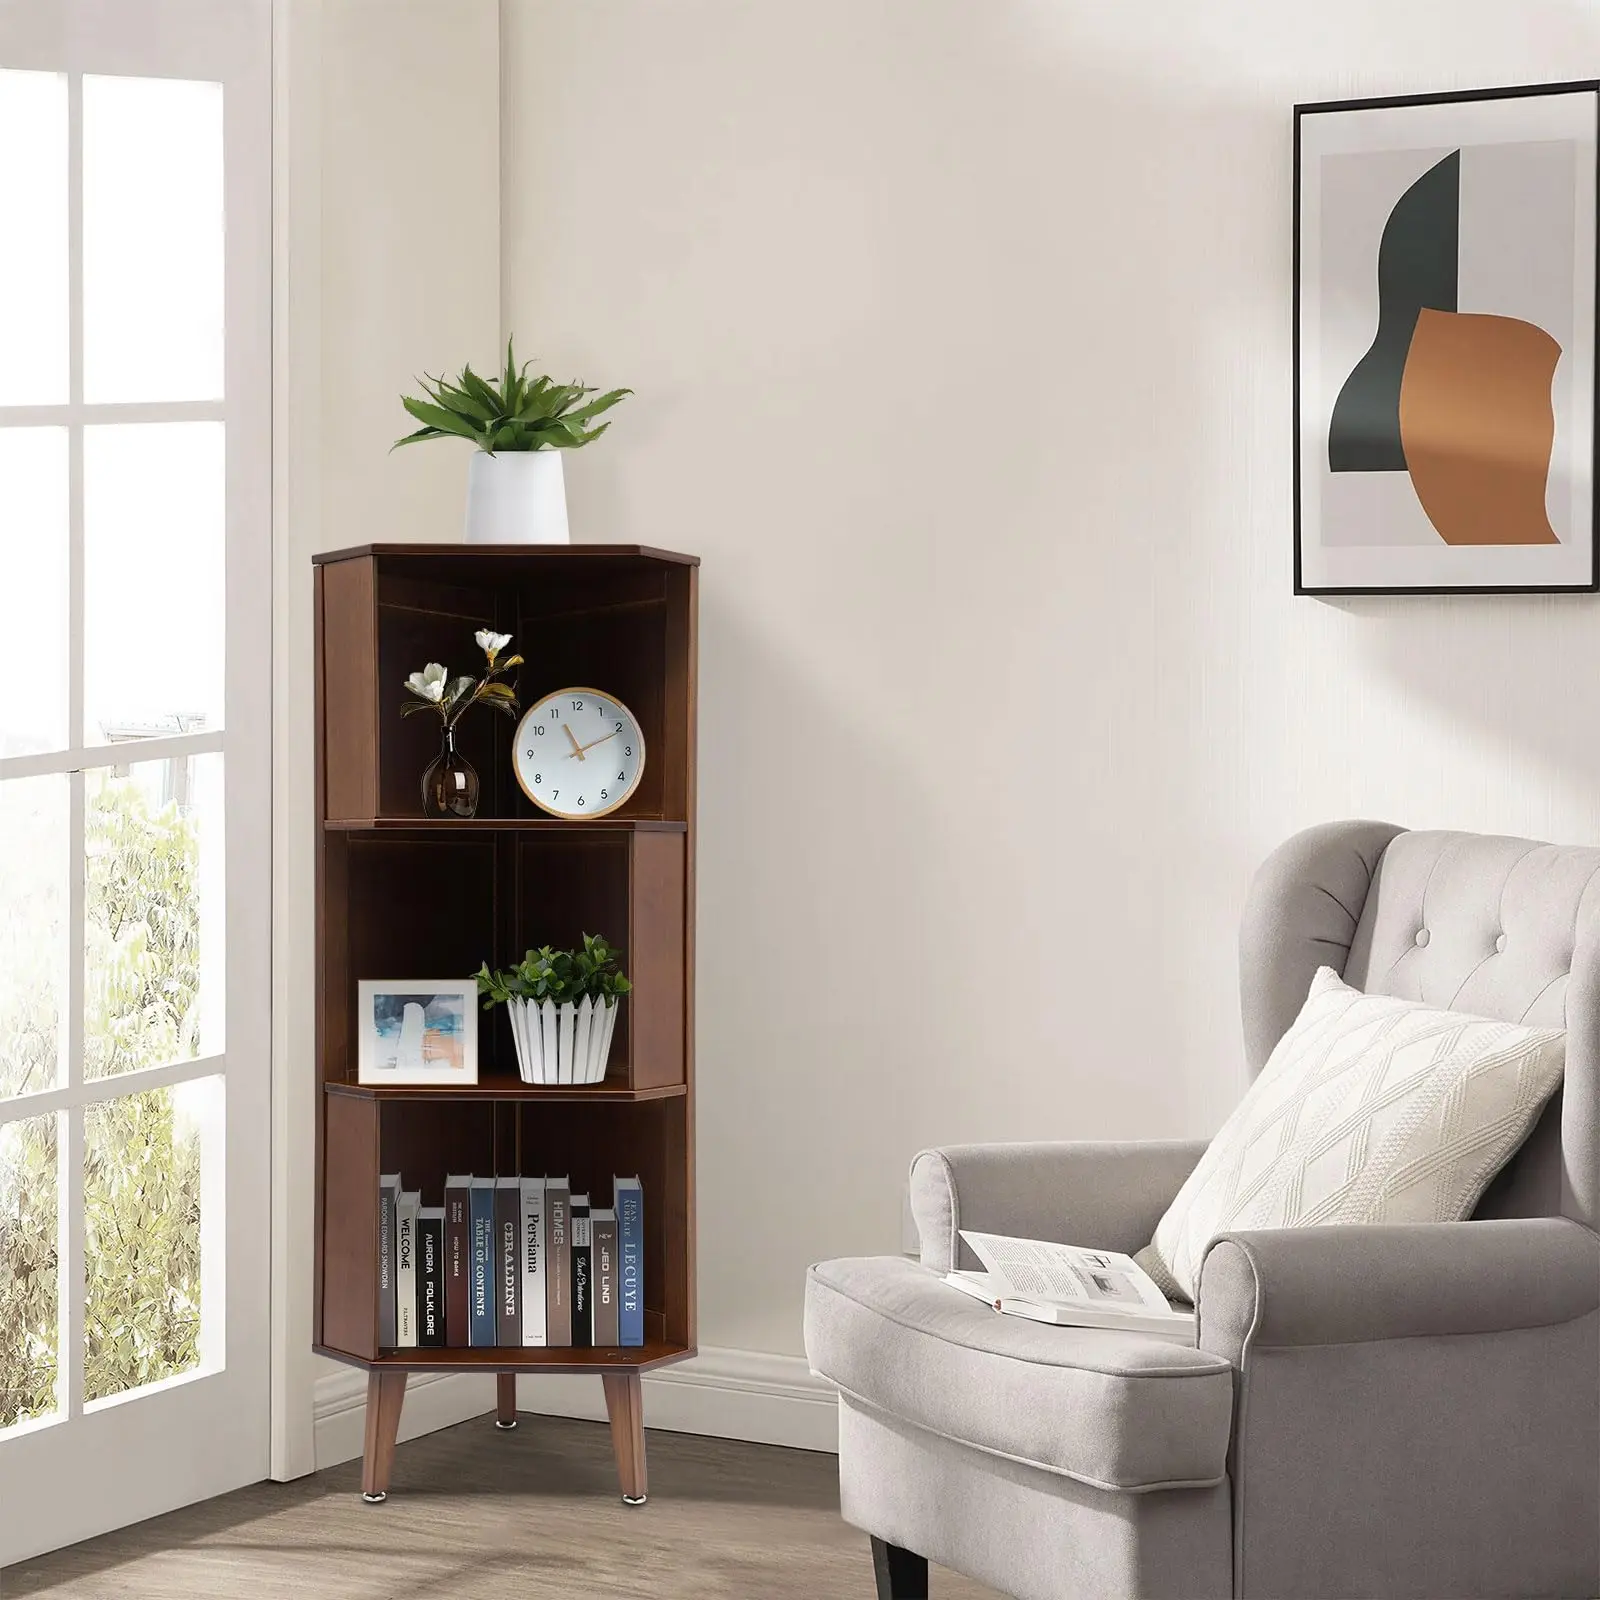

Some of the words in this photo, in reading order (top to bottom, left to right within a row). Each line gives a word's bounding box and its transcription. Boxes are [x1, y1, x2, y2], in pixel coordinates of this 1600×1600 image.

[572, 701, 583, 710] 12
[550, 709, 559, 718] 11
[599, 708, 603, 716] 1
[534, 726, 544, 735] 10
[616, 723, 622, 732] 2
[527, 750, 534, 759] 9
[625, 747, 631, 756] 3
[535, 774, 542, 783] 8
[618, 772, 624, 781] 4
[553, 790, 559, 800] 7
[601, 789, 607, 799] 5
[578, 796, 584, 805] 6
[553, 1201, 563, 1244] HOMES
[475, 1217, 483, 1247] TABLE
[401, 1218, 410, 1269] WELCOME
[527, 1214, 539, 1273] Persiana
[425, 1234, 434, 1273] AURORA
[476, 1250, 483, 1263] OF
[625, 1243, 636, 1311] LECUYE
[476, 1264, 484, 1316] CONTENTS
[426, 1281, 434, 1335] FOLKLORE
